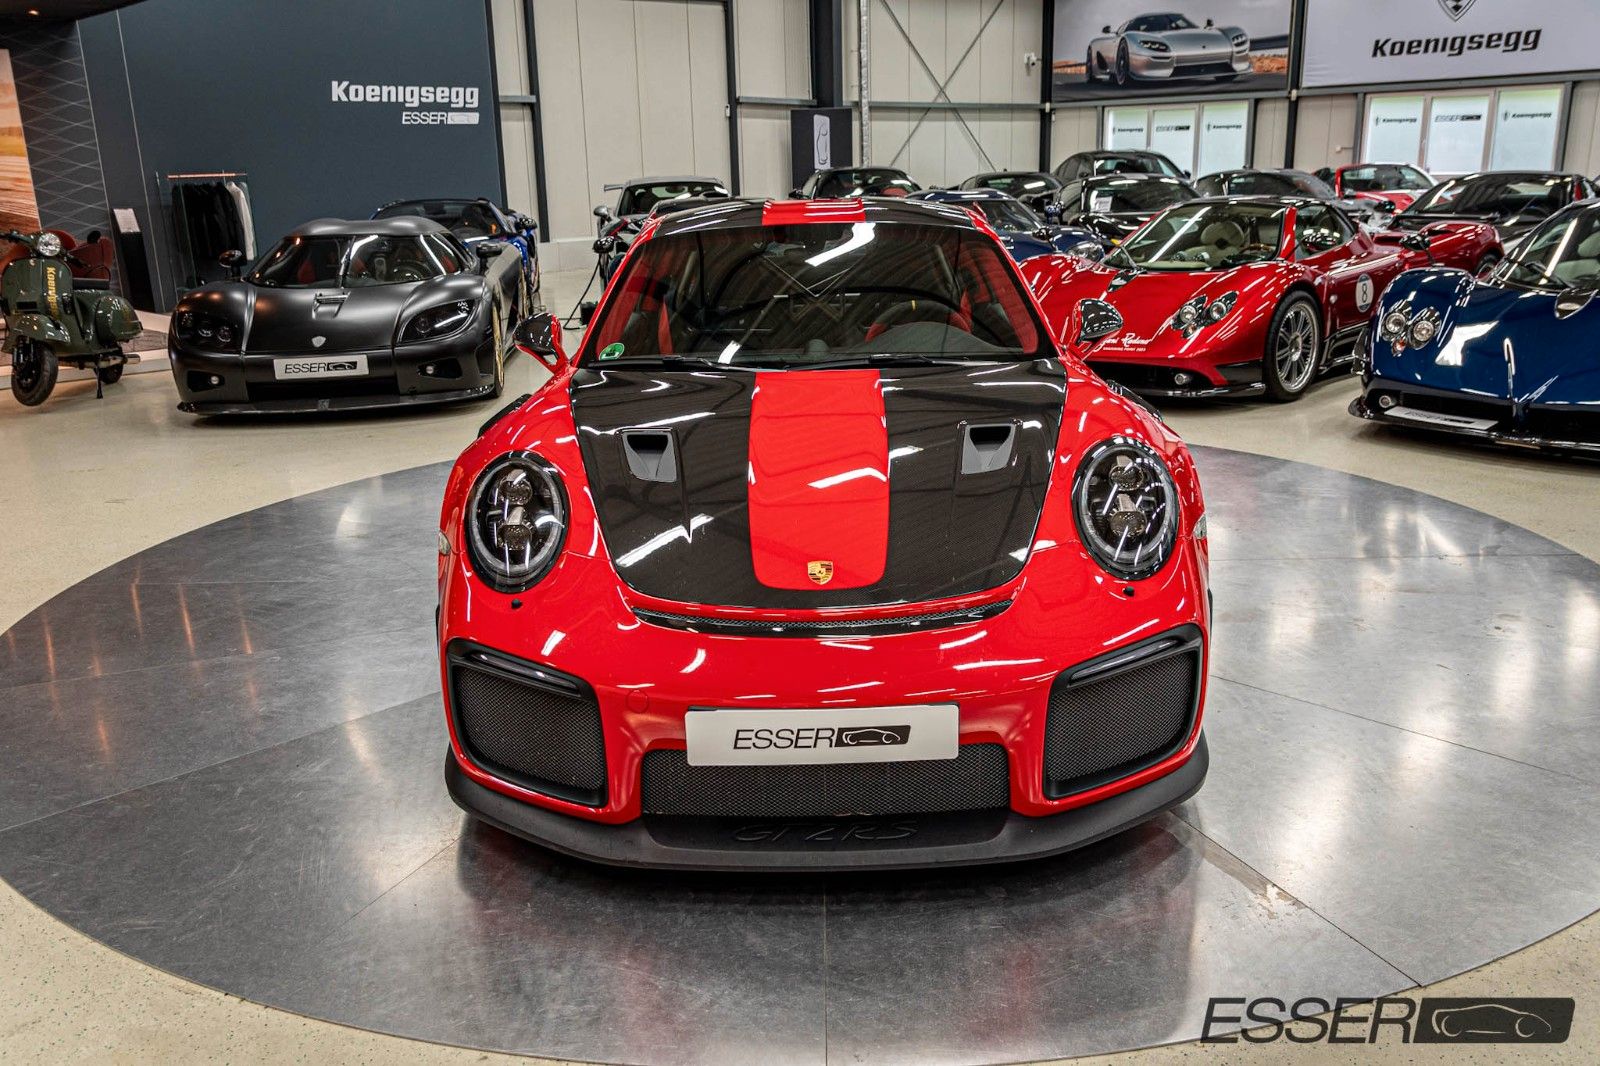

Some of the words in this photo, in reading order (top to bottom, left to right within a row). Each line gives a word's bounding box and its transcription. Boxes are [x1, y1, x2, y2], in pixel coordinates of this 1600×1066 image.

[1371, 28, 1543, 58] Koenigsegg
[331, 80, 480, 108] Koenigsegg
[402, 111, 447, 125] ESSER
[1361, 283, 1368, 303] 8
[284, 362, 327, 374] ESSER
[733, 728, 836, 750] ESSER
